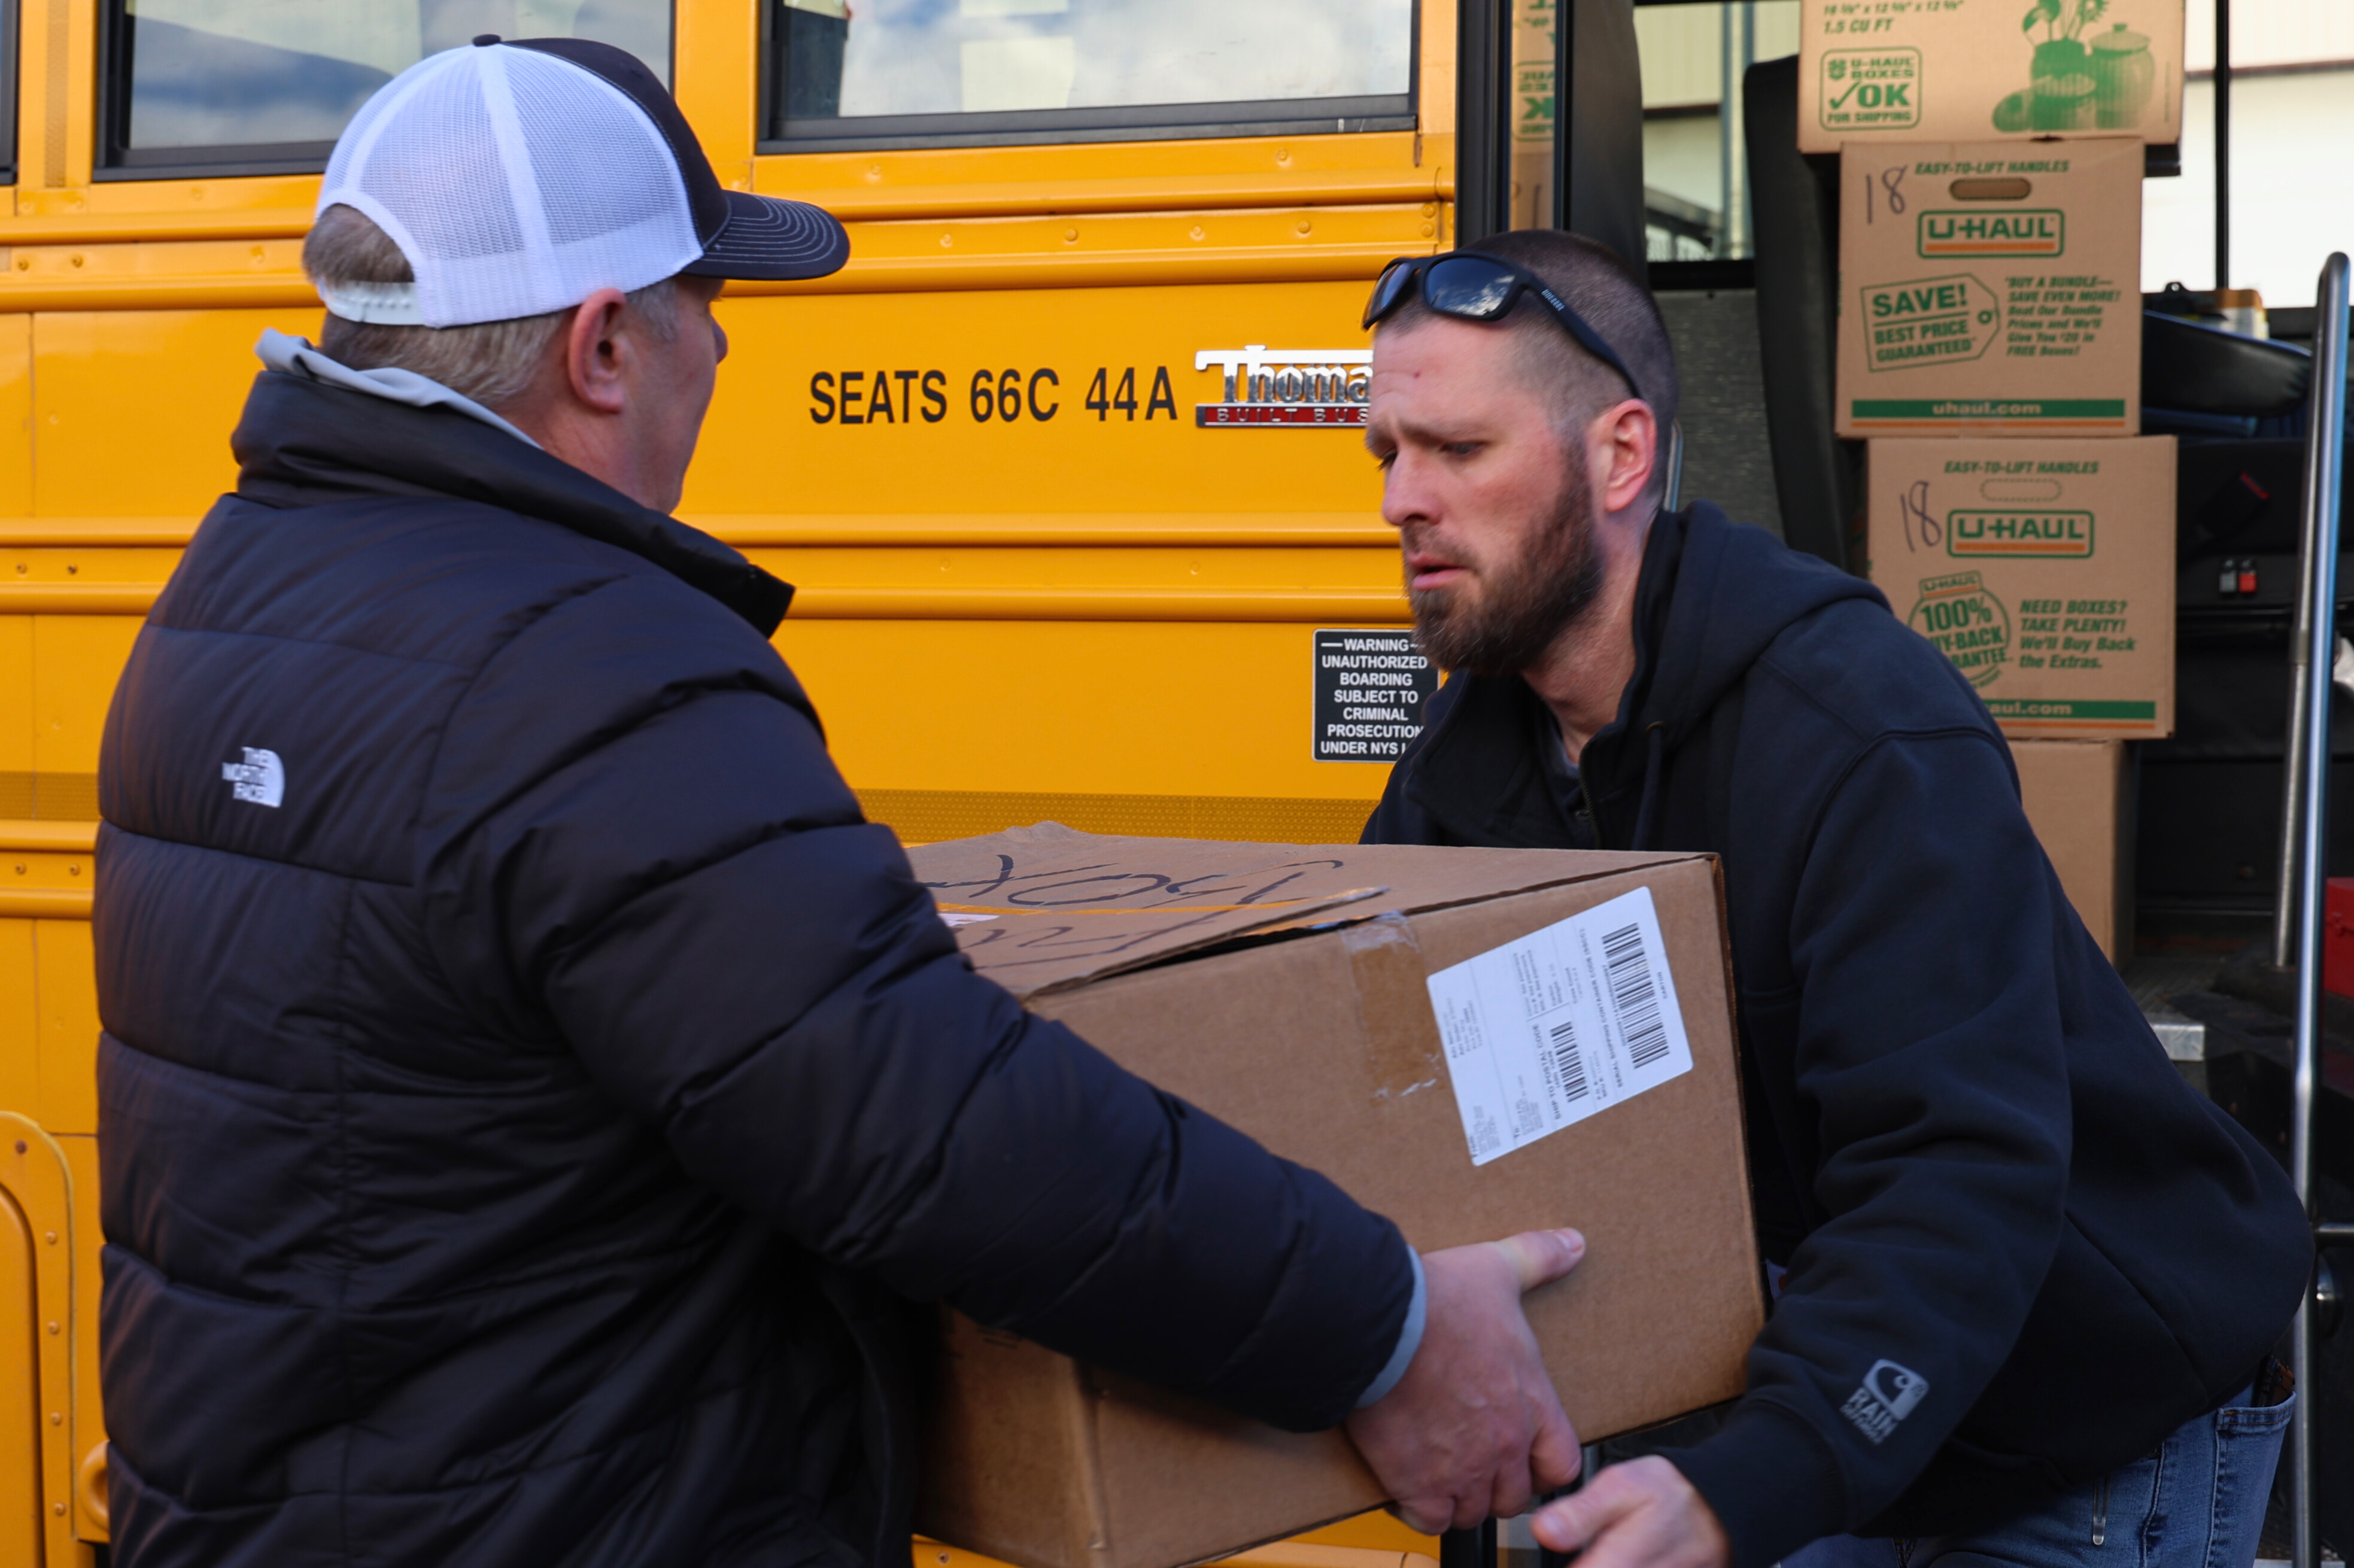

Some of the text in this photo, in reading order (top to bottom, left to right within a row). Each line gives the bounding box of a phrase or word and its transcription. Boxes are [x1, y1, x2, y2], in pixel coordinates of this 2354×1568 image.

[1824, 19, 1893, 34] 1.5 CU FT
[1851, 69, 1913, 79] BOXES
[1857, 84, 1910, 108] OK
[1915, 160, 2070, 175] EASY-TO-LIFT HANDLES
[1866, 165, 1908, 225] 18
[1927, 217, 2055, 239] U-HAUL
[1872, 283, 1968, 318] SAVE!
[2007, 291, 2039, 302] SAVE
[2043, 291, 2076, 302] EVEN
[1874, 320, 1969, 345] BEST PRICE
[2006, 345, 2036, 356] FREE
[1195, 345, 1374, 403] Thoma
[809, 366, 1178, 424] SEATS 66C 44A
[1217, 408, 1369, 422] BUILT BUS
[1933, 401, 2042, 415] uhaul.com
[1944, 461, 2099, 474] EASY-TO-LIFT HANDLES
[1900, 481, 1942, 552] 18
[1957, 518, 2084, 539] U-HAUL
[1920, 597, 1992, 632] 100%
[2020, 600, 2127, 614] NEED BOXES?
[2021, 618, 2127, 633] TAKE PLENTY!
[1344, 639, 1409, 652] WARNING
[1930, 626, 2003, 652] UY-BACK
[2020, 636, 2136, 653] We'll Buy Back
[1322, 655, 1427, 668] UNAUTHORIZED
[2019, 655, 2103, 668] the Extras.
[1340, 673, 1413, 686] BOARDING
[1334, 690, 1419, 703] SUBJECT TO
[1343, 707, 1409, 721] CRIMINAL
[1990, 701, 2072, 715] aul.com
[1320, 742, 1368, 754] UNDER
[1371, 742, 1398, 755] NYS
[1584, 956, 1596, 979] CODE
[1590, 979, 1607, 1023] CONTAINER
[1601, 1023, 1616, 1060] SHIPPING
[1531, 1023, 1562, 1120] SHIP TO POSTAL CODE
[1611, 1061, 1623, 1089] SERIAL
